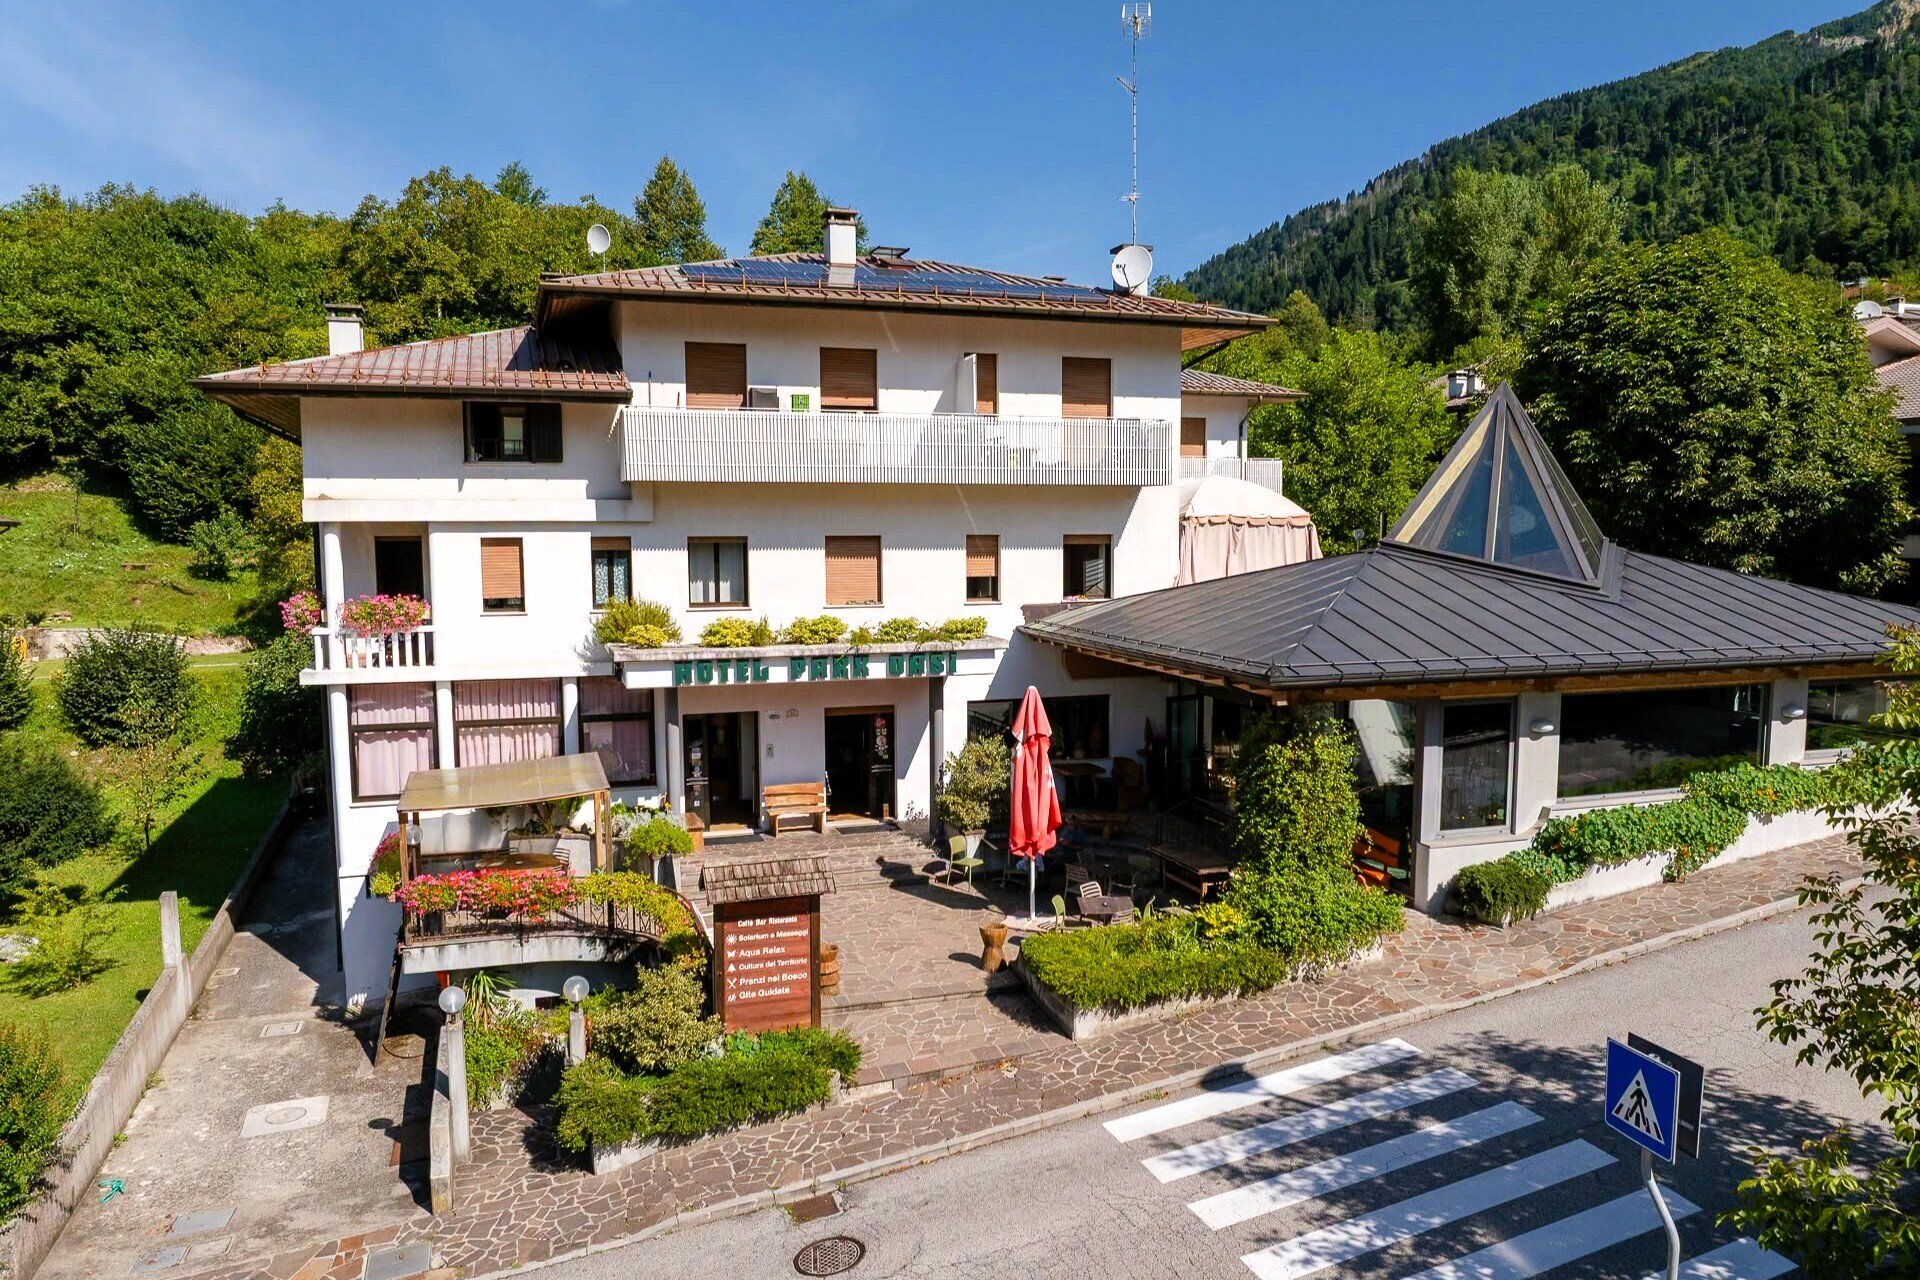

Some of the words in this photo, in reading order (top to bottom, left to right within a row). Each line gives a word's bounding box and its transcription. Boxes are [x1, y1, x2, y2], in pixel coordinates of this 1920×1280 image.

[674, 657, 769, 686] HOTEL
[788, 654, 870, 681] PARK
[888, 651, 957, 677] OASI
[755, 918, 767, 926] Bar
[768, 916, 798, 925] Ristorante
[738, 933, 769, 942] Solarium
[776, 928, 809, 938] Massaggi
[739, 949, 761, 958] Aqua
[762, 946, 786, 955] Relax
[739, 962, 764, 971] Cultura
[777, 957, 808, 967] Territorio
[739, 976, 766, 986] Pranzi
[767, 975, 780, 983] nel
[781, 972, 808, 981] Bosco
[739, 990, 757, 1000] Gite
[758, 987, 790, 997] Guidate
